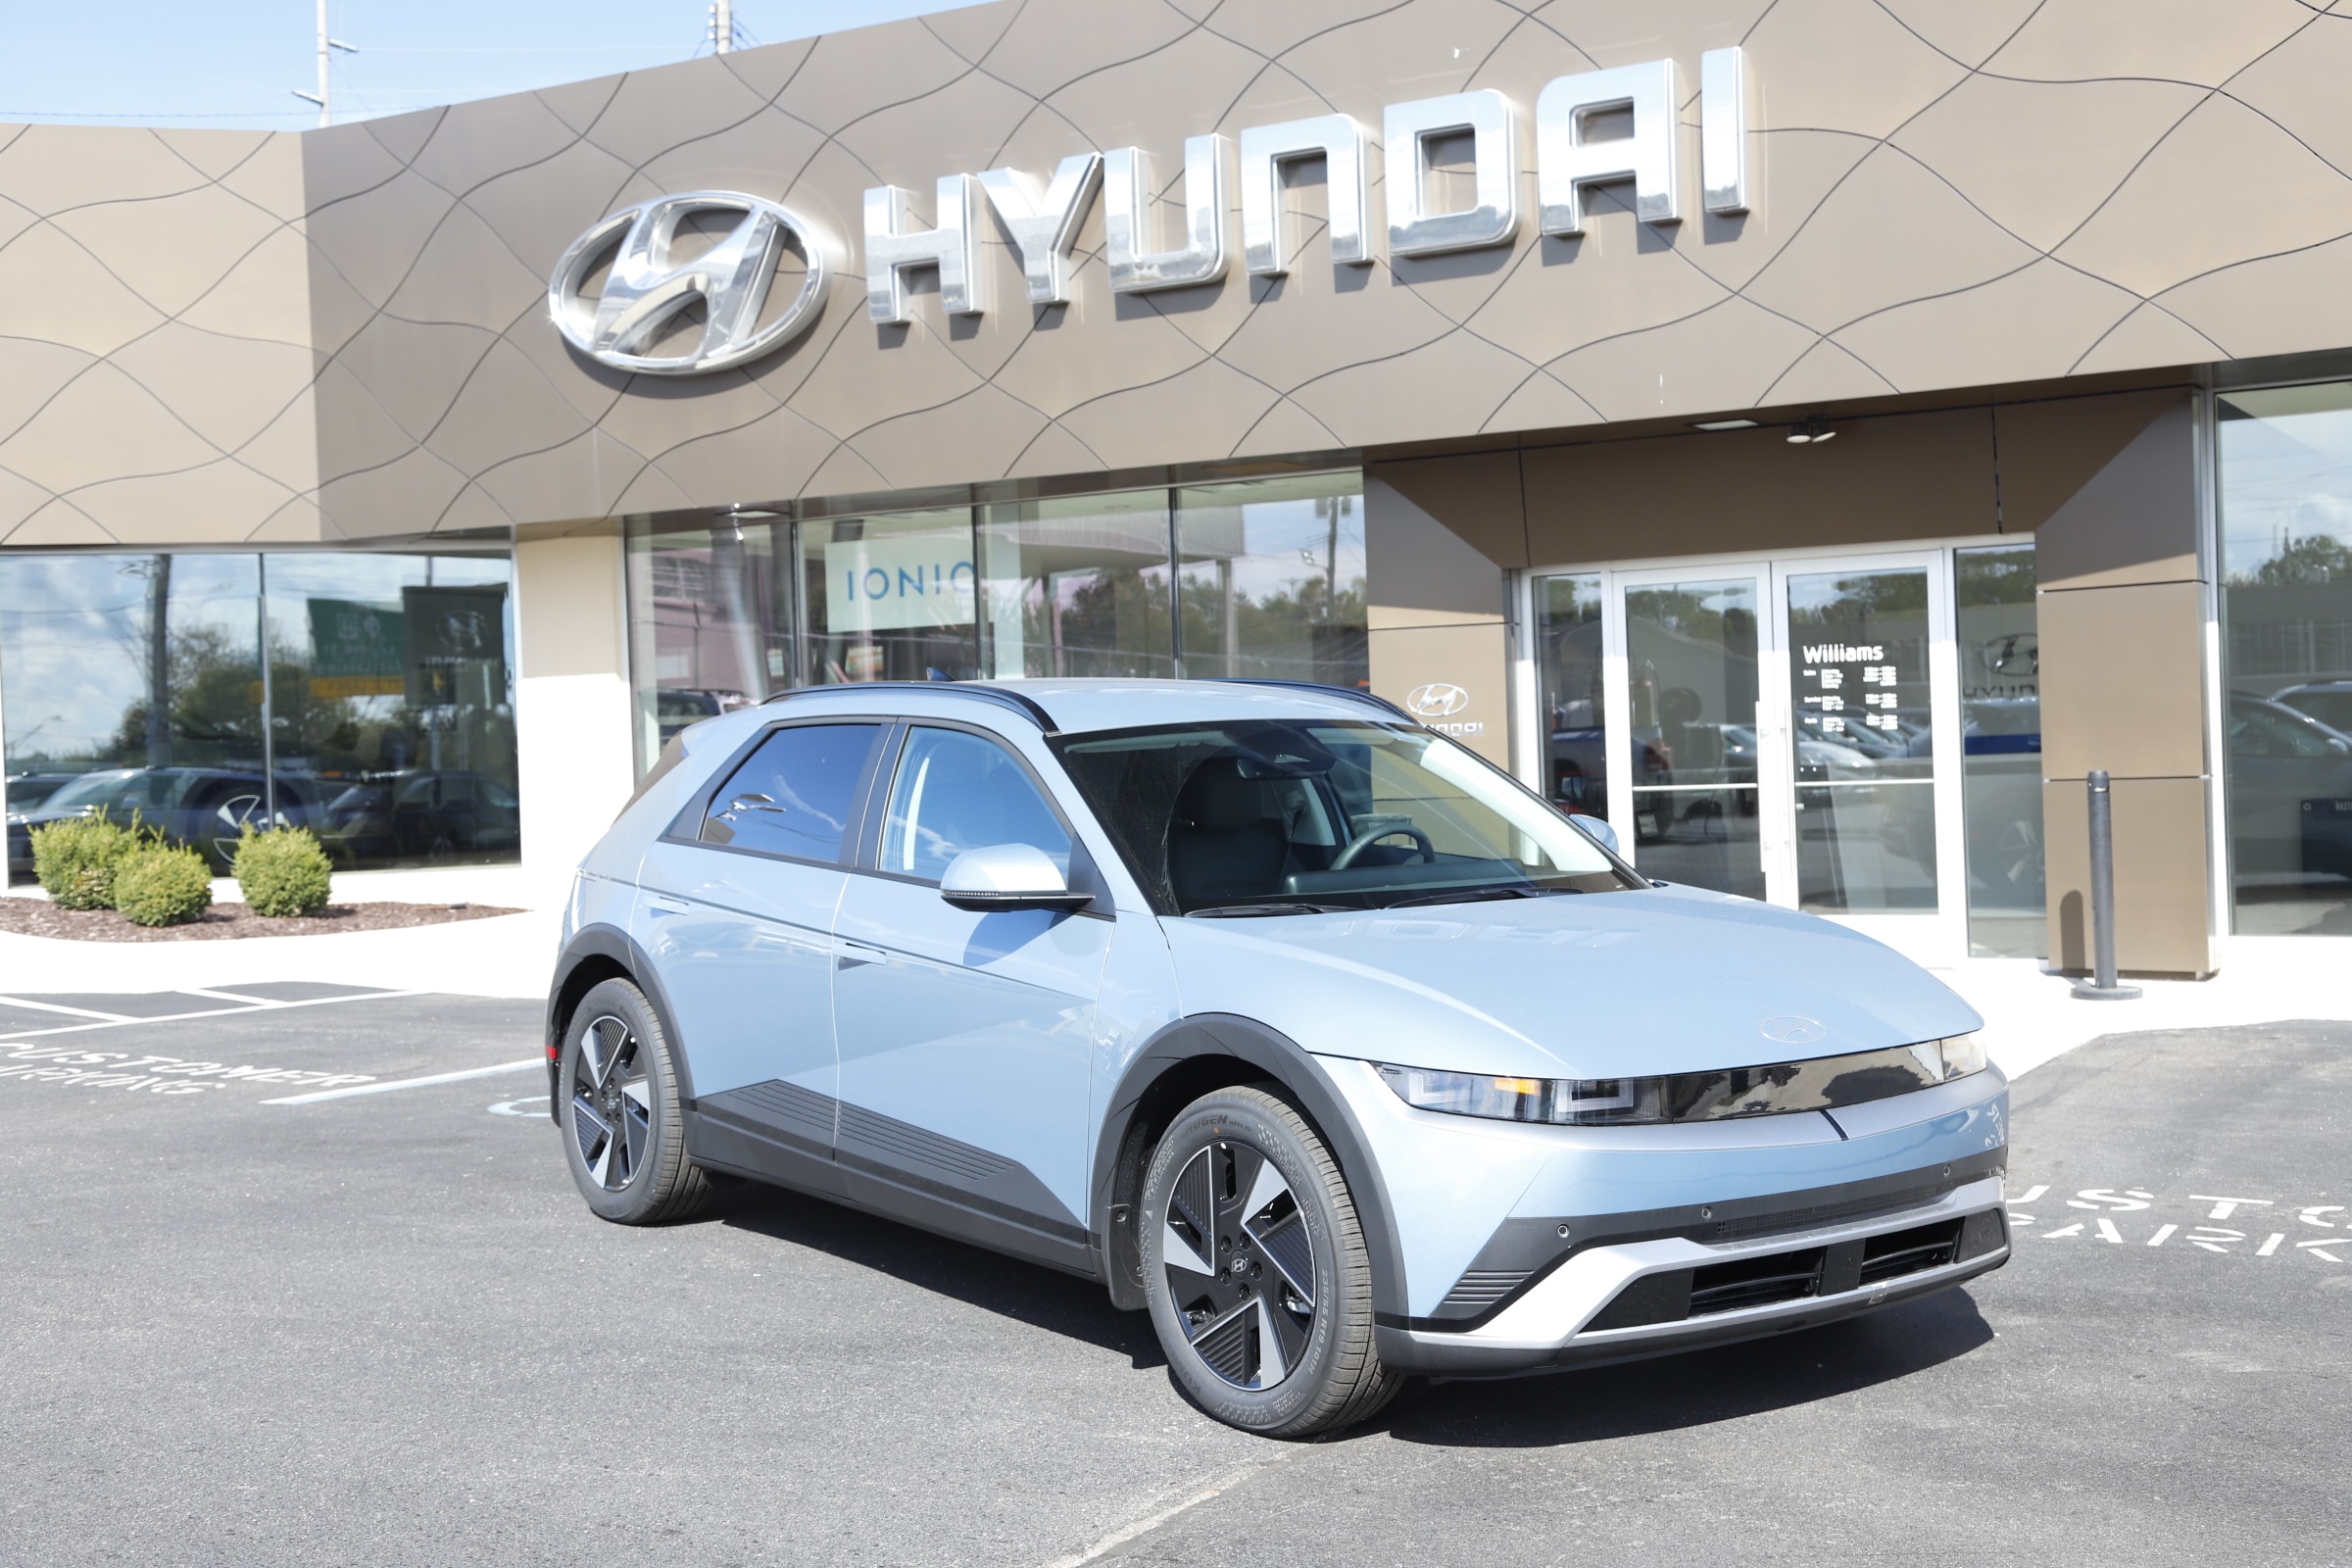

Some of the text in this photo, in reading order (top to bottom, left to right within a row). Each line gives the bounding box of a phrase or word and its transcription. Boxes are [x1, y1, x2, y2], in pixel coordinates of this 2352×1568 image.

[863, 46, 1749, 324] HYUNDAI
[1802, 643, 1885, 664] Williams
[1430, 722, 1484, 737] NDAI
